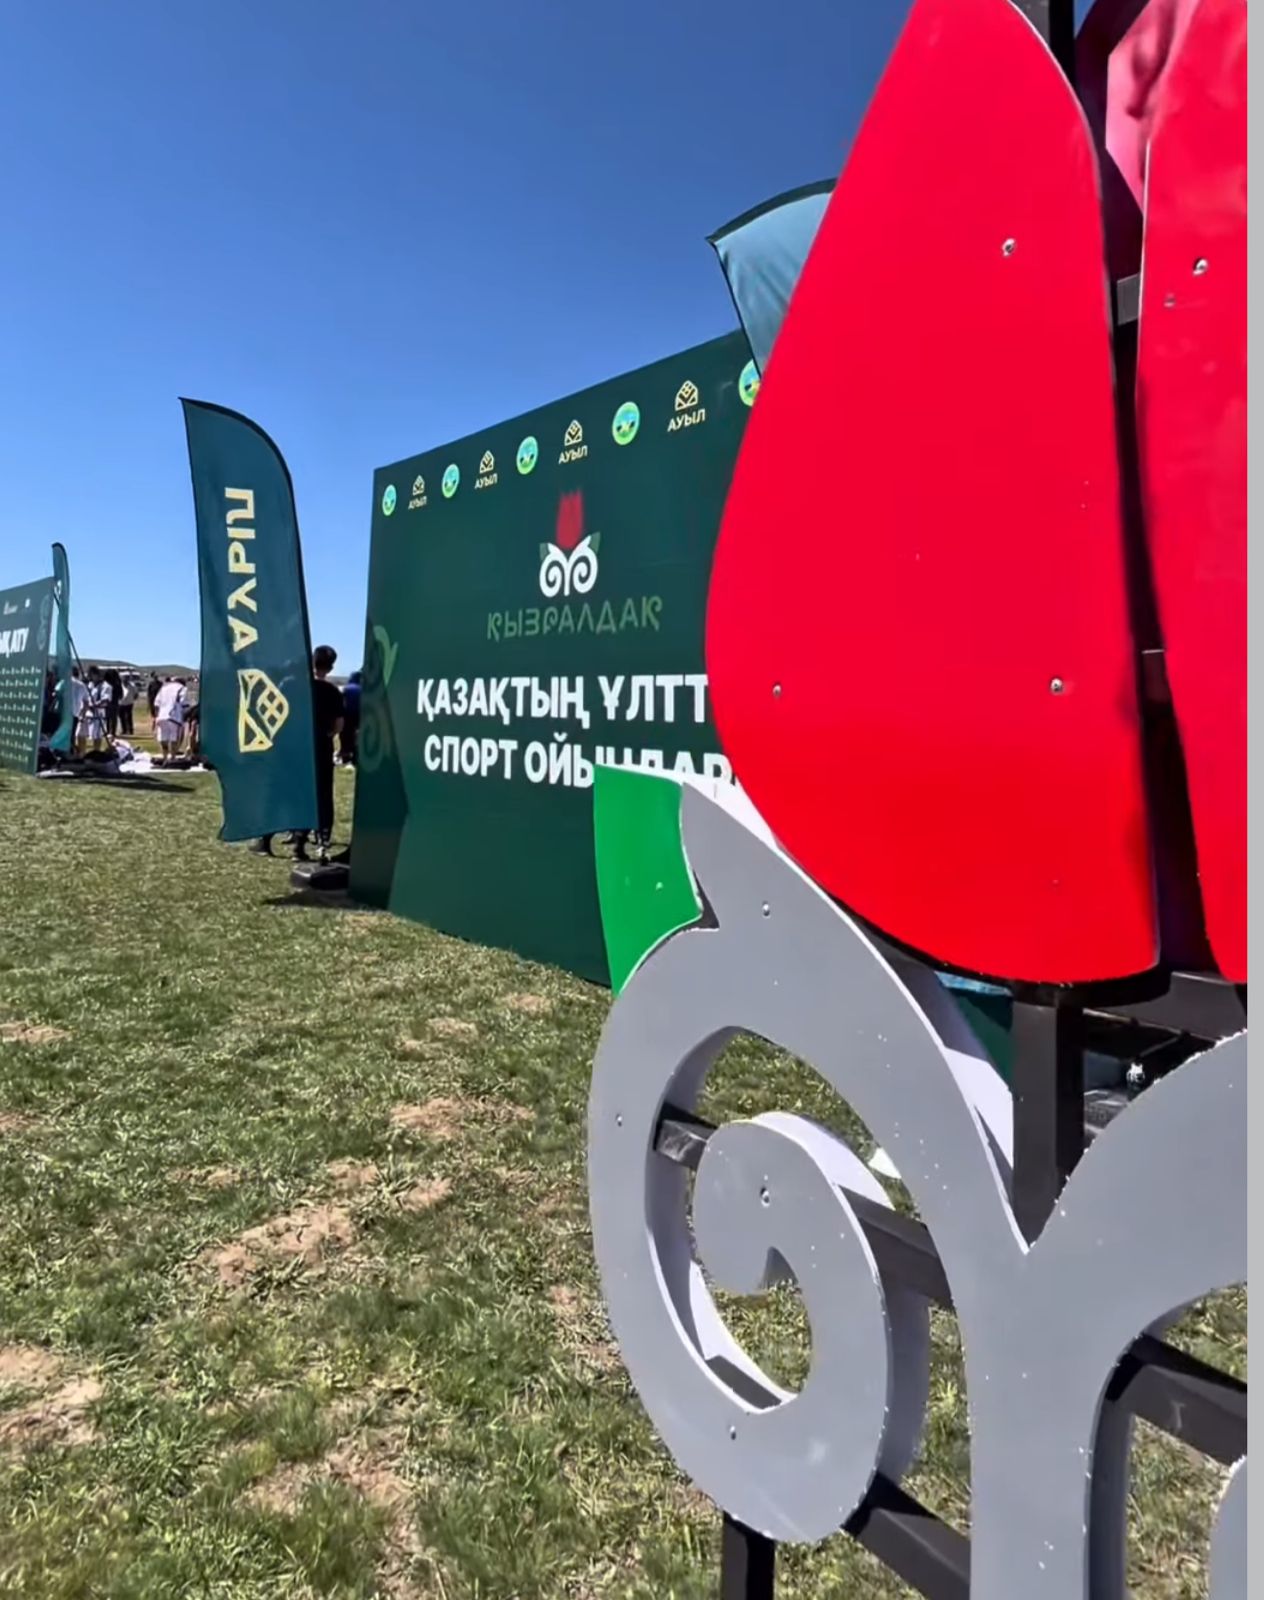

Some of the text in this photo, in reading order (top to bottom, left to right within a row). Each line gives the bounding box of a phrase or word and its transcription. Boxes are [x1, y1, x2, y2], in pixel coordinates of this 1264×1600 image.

[667, 408, 706, 433] АУЫЛ
[558, 445, 588, 465] АУЫЛ
[474, 473, 498, 490] АУЫЛ
[416, 676, 591, 729] ҚАЗАҚТЫҢ
[424, 735, 518, 779] СПОРТ
